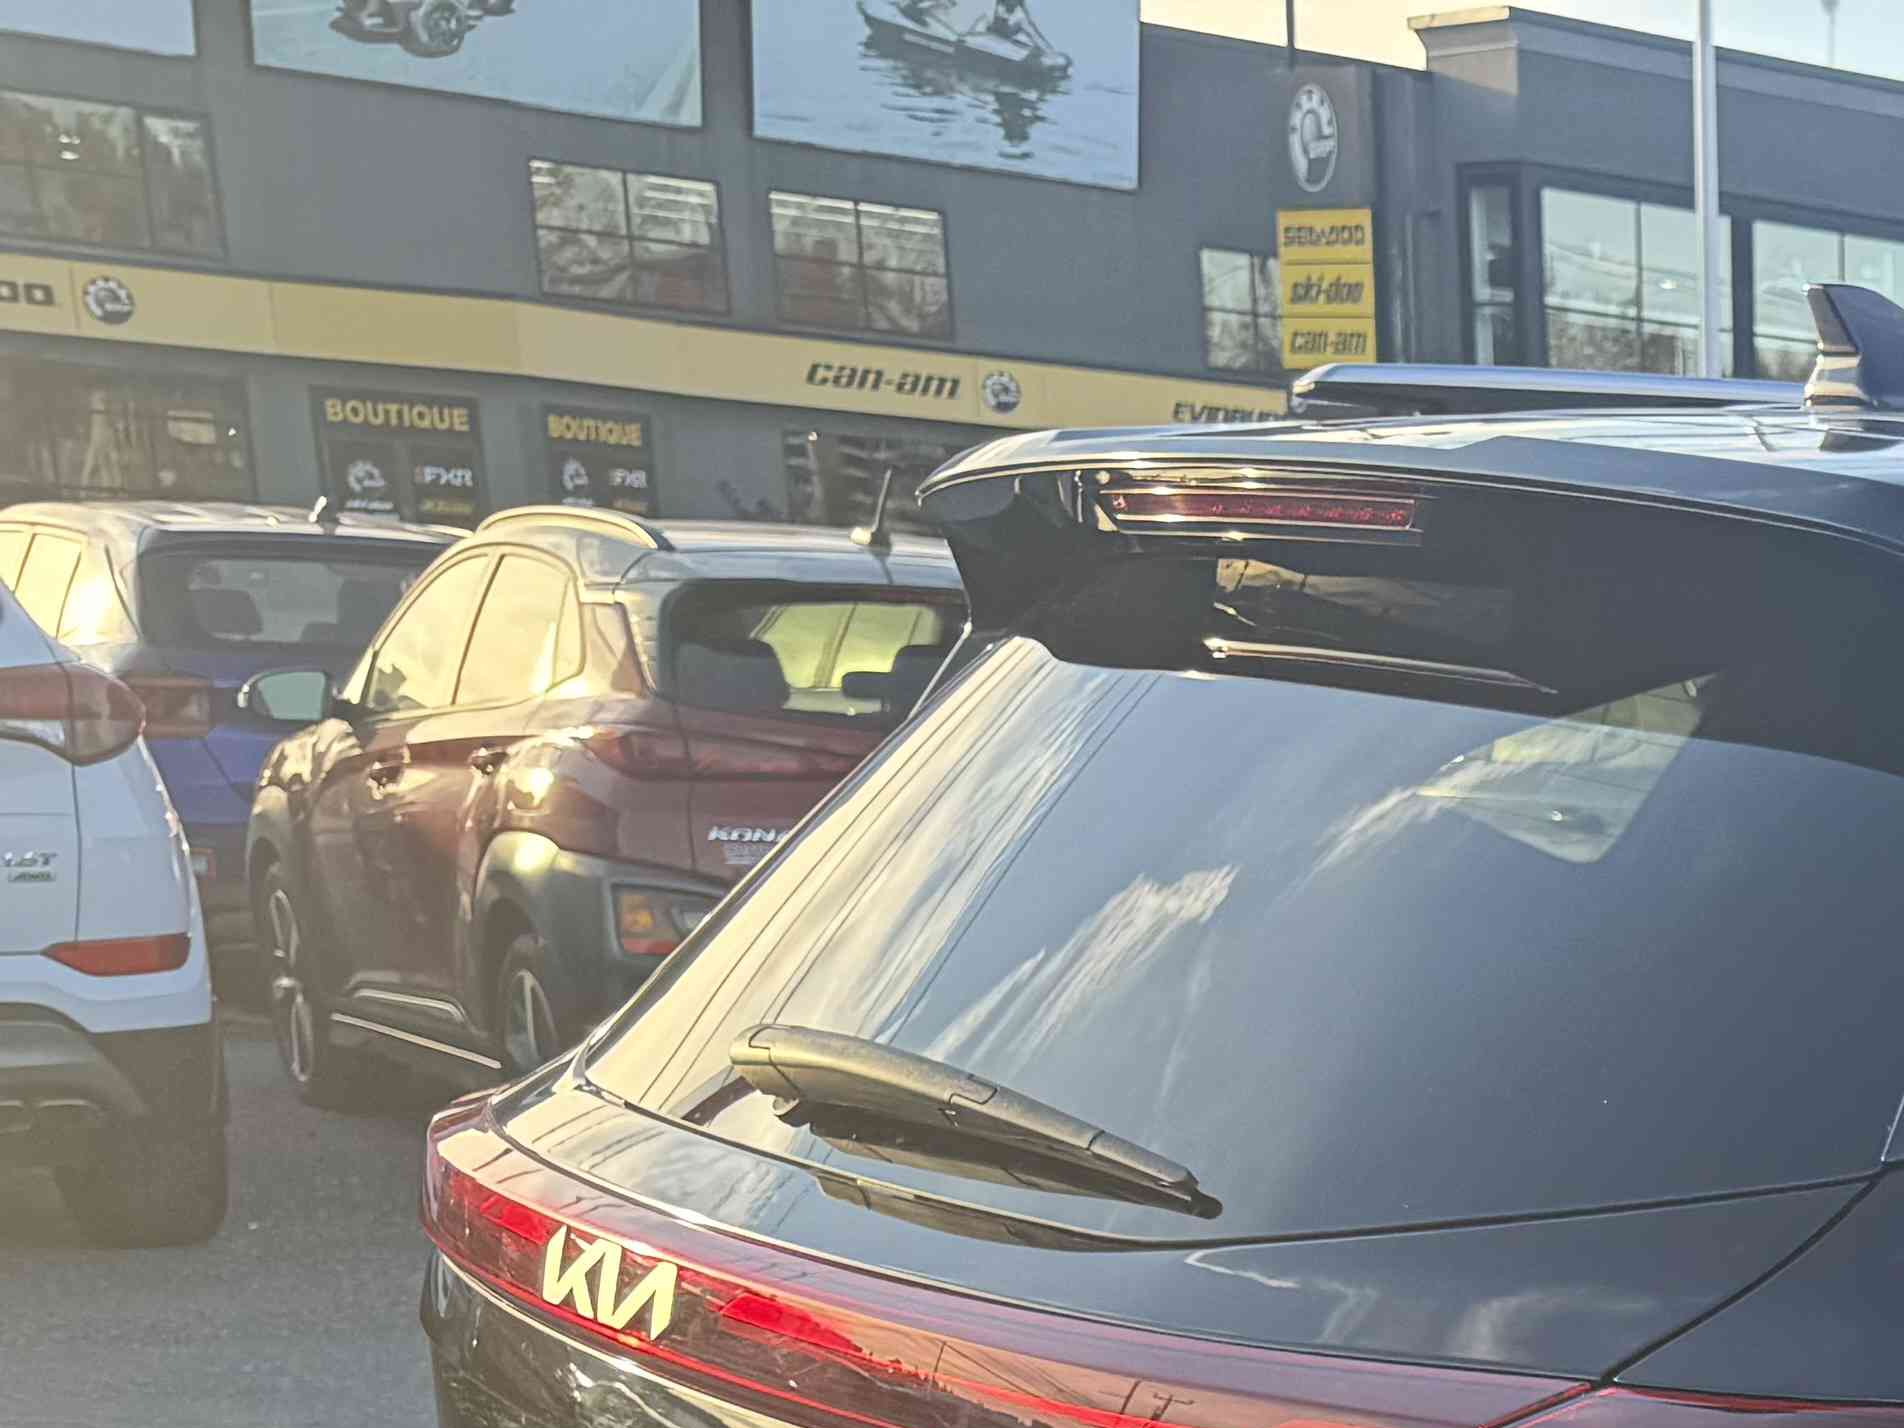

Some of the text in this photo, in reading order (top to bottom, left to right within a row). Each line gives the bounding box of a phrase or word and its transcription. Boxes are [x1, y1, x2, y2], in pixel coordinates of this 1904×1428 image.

[1291, 329, 1367, 355] can-am
[806, 361, 961, 399] can-am
[324, 397, 471, 432] BOUTIQUE
[547, 414, 642, 447] BOUTIQUE
[542, 1224, 678, 1341] KIA
